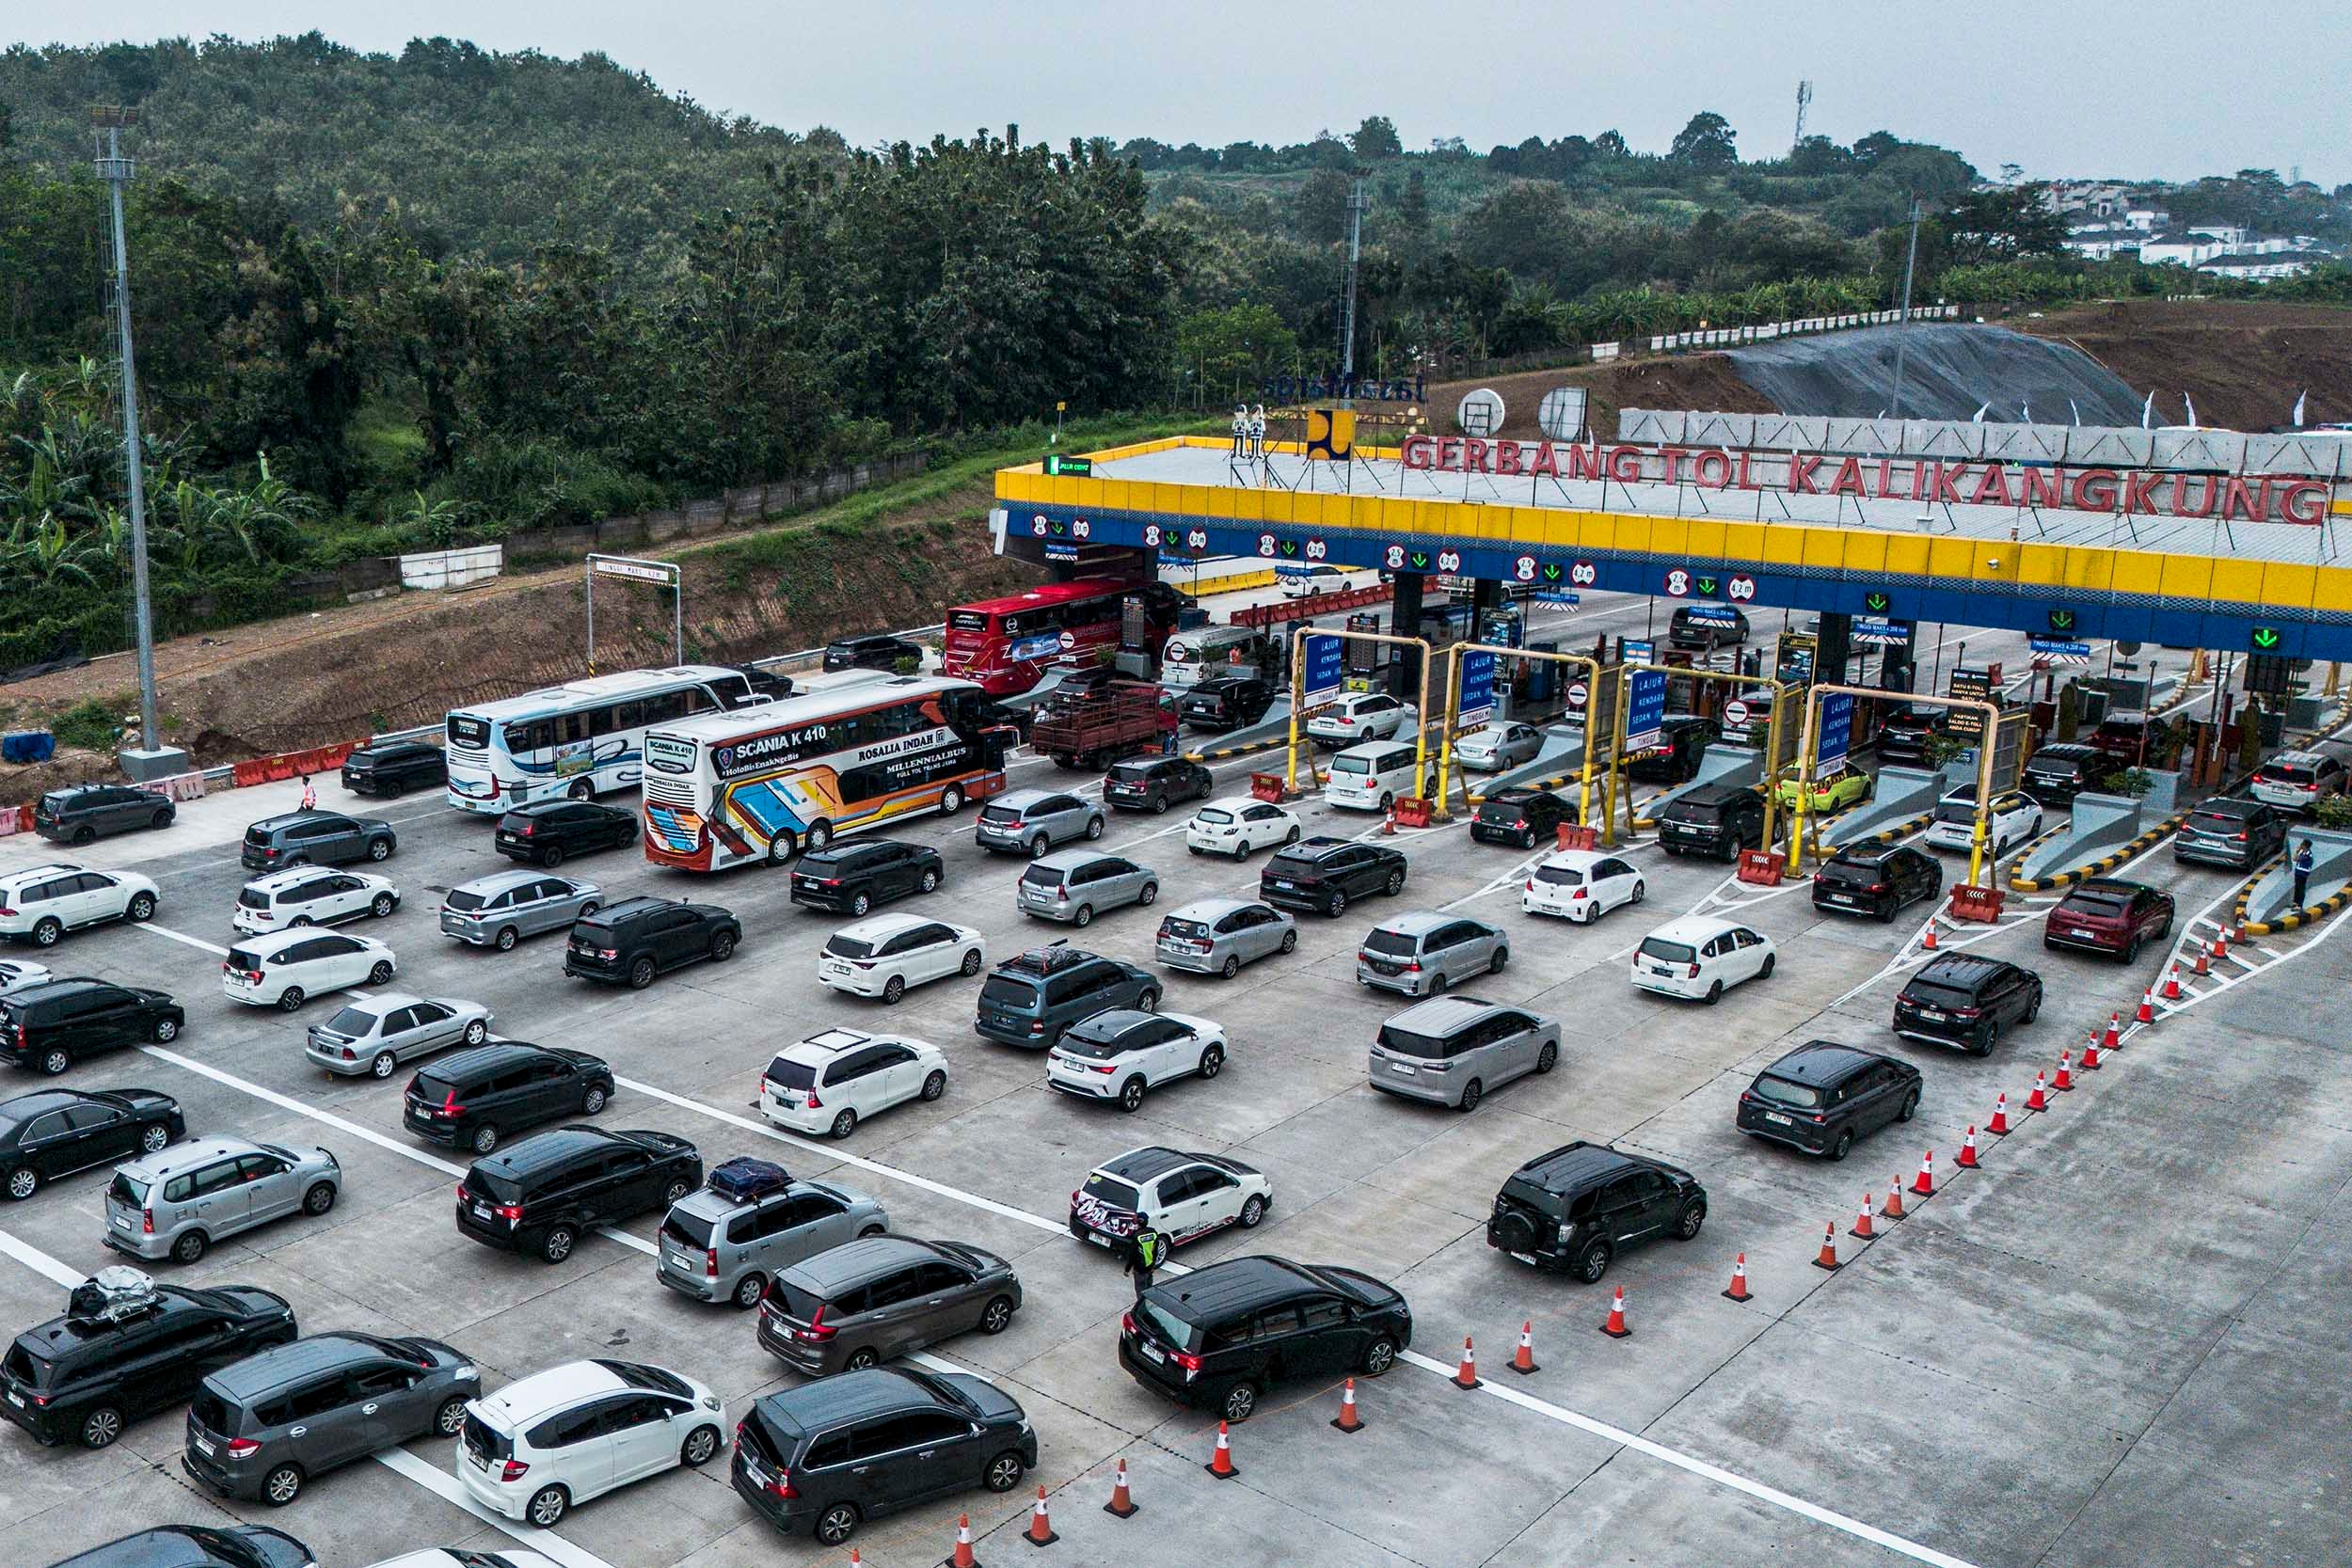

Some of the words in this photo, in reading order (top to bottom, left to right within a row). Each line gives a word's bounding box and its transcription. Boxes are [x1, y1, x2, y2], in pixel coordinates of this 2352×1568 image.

[1401, 435, 1641, 483] GERBANG
[1659, 447, 1763, 491] TOL
[1788, 454, 2329, 526] KALIKANGKUNG
[1321, 640, 1339, 652] LAJUR
[1471, 656, 1491, 670] LAJUR
[1639, 677, 1662, 691] LAJUR
[1831, 698, 1850, 714] LAJUR
[649, 741, 674, 752] SCANIA
[736, 736, 789, 758] SCANIA
[792, 732, 802, 745] K
[803, 726, 826, 742] 410
[858, 743, 901, 761] ROSALIA
[903, 734, 933, 751] INDAH
[886, 747, 967, 773] MILLENNIALBUS
[653, 778, 674, 788] ROSALIA
